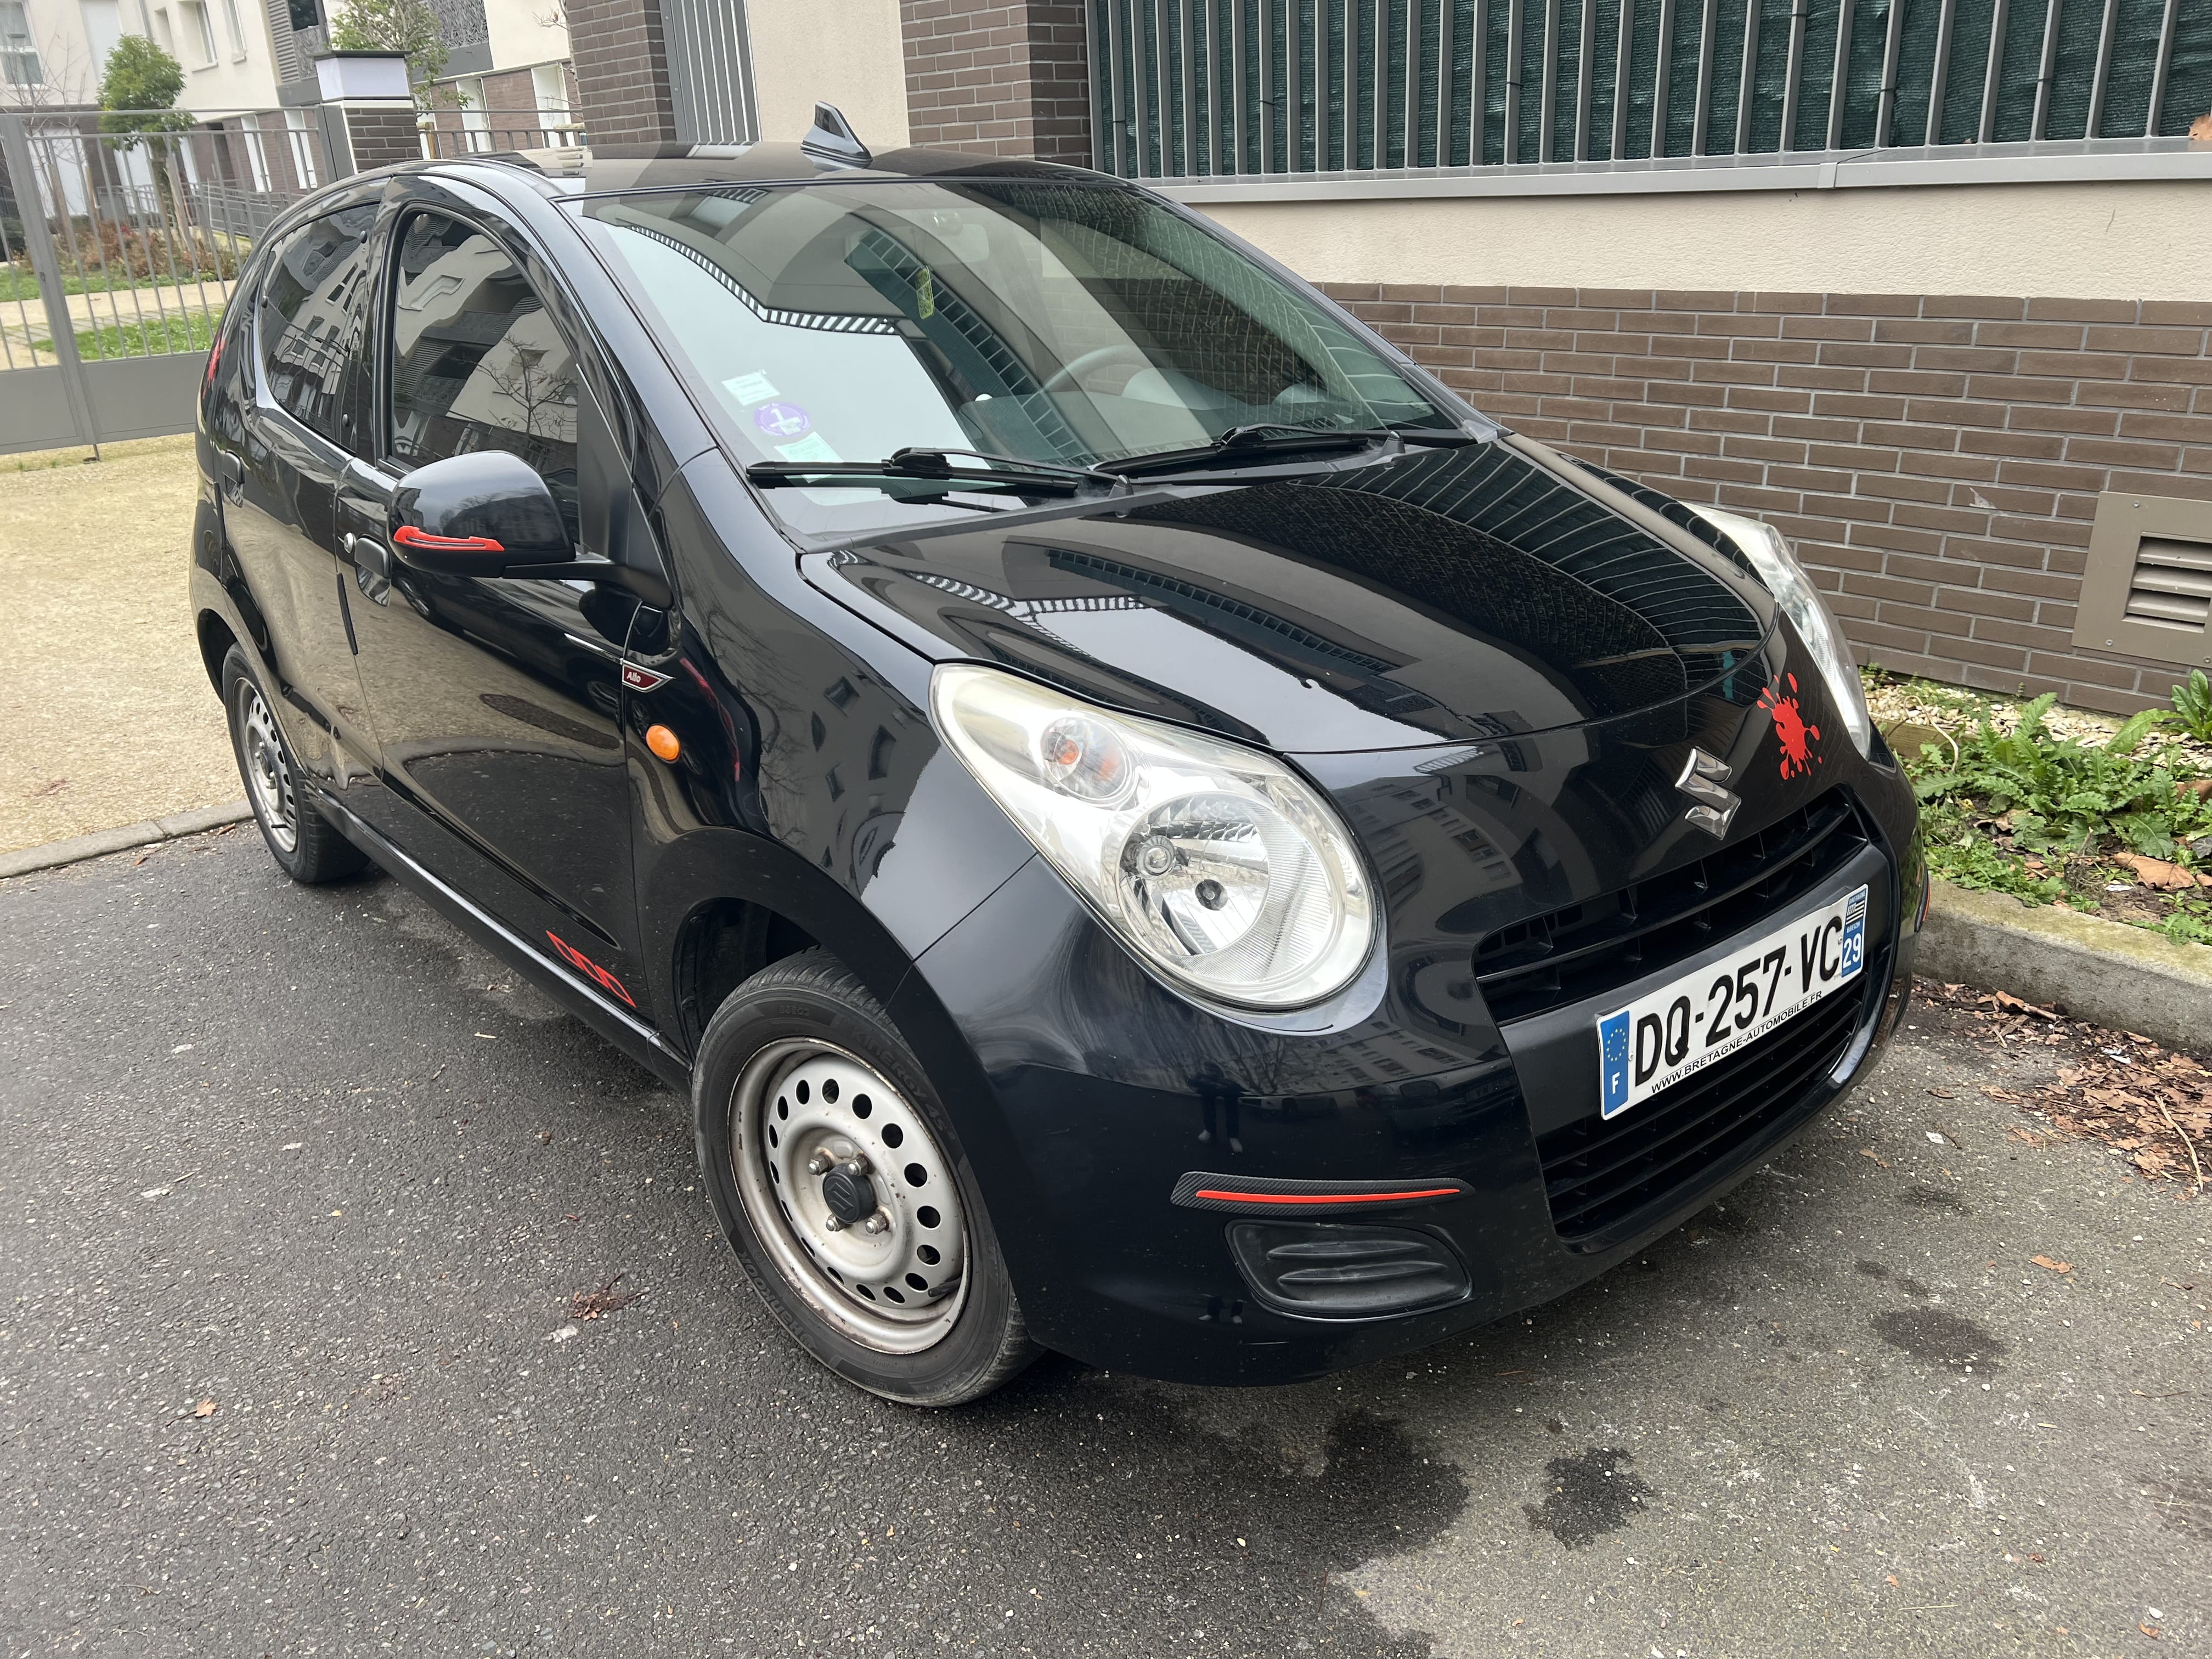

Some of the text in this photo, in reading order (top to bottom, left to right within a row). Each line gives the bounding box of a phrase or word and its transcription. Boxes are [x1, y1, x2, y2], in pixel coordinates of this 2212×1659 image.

[1843, 933, 1861, 969] 29
[1634, 916, 1842, 1087] DQ-257-VC
[1651, 991, 1822, 1093] WWW.BRETAGNE-AUTOMOBILE.FR
[1612, 1071, 1620, 1095] F
